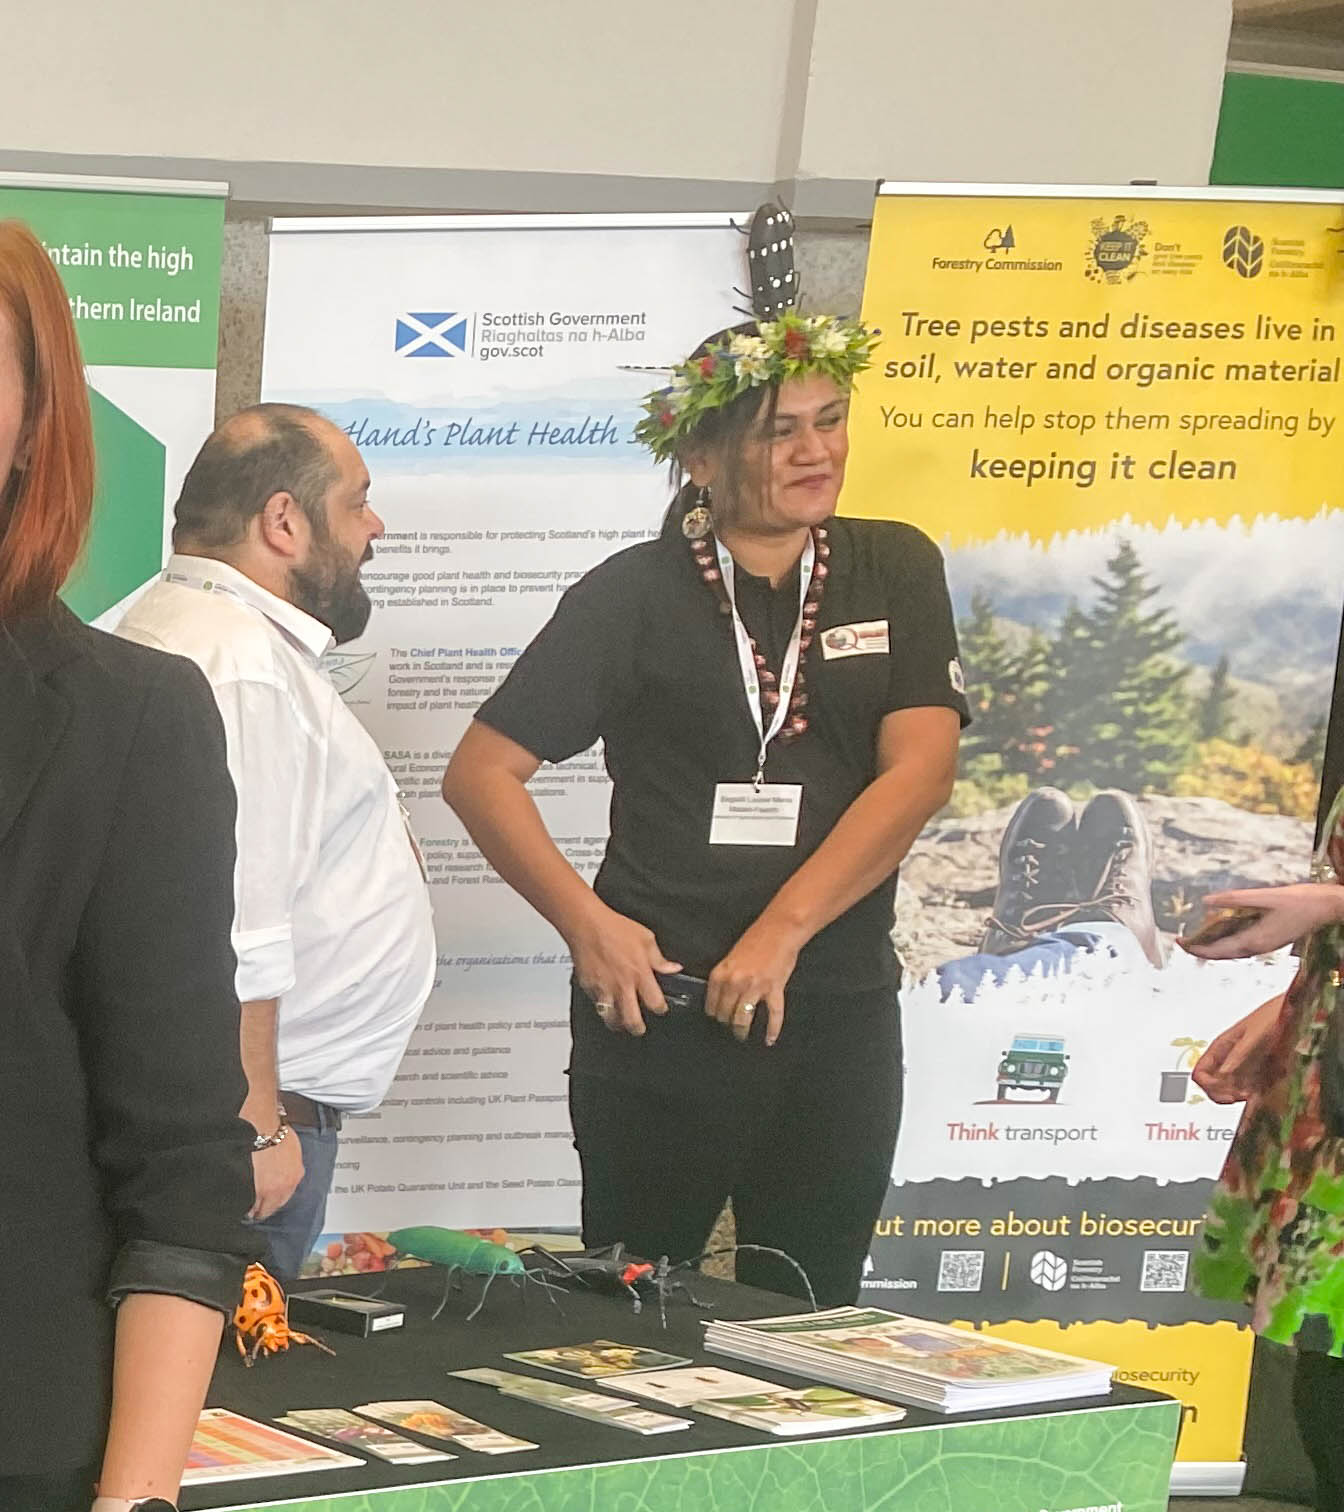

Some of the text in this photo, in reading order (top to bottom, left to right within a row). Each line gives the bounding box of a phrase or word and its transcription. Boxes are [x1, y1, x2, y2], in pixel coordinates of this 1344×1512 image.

[108, 243, 193, 276] the high
[932, 257, 1063, 273] Forestry Commission
[129, 297, 201, 323] Ireland
[482, 312, 647, 326] Scottish Government
[481, 328, 645, 346] Riaghaltas na h-Alba
[902, 311, 1335, 343] Tree pests and diseases live in
[480, 345, 544, 361] gov.scot
[884, 353, 1340, 387] soil, water and organic material
[443, 418, 519, 447] Plant
[527, 414, 618, 447] Health
[437, 648, 463, 658] Plant
[465, 647, 497, 657] Health
[947, 1122, 1098, 1145] Think transport
[1145, 1122, 1200, 1141] Think
[913, 1211, 1071, 1237] more about
